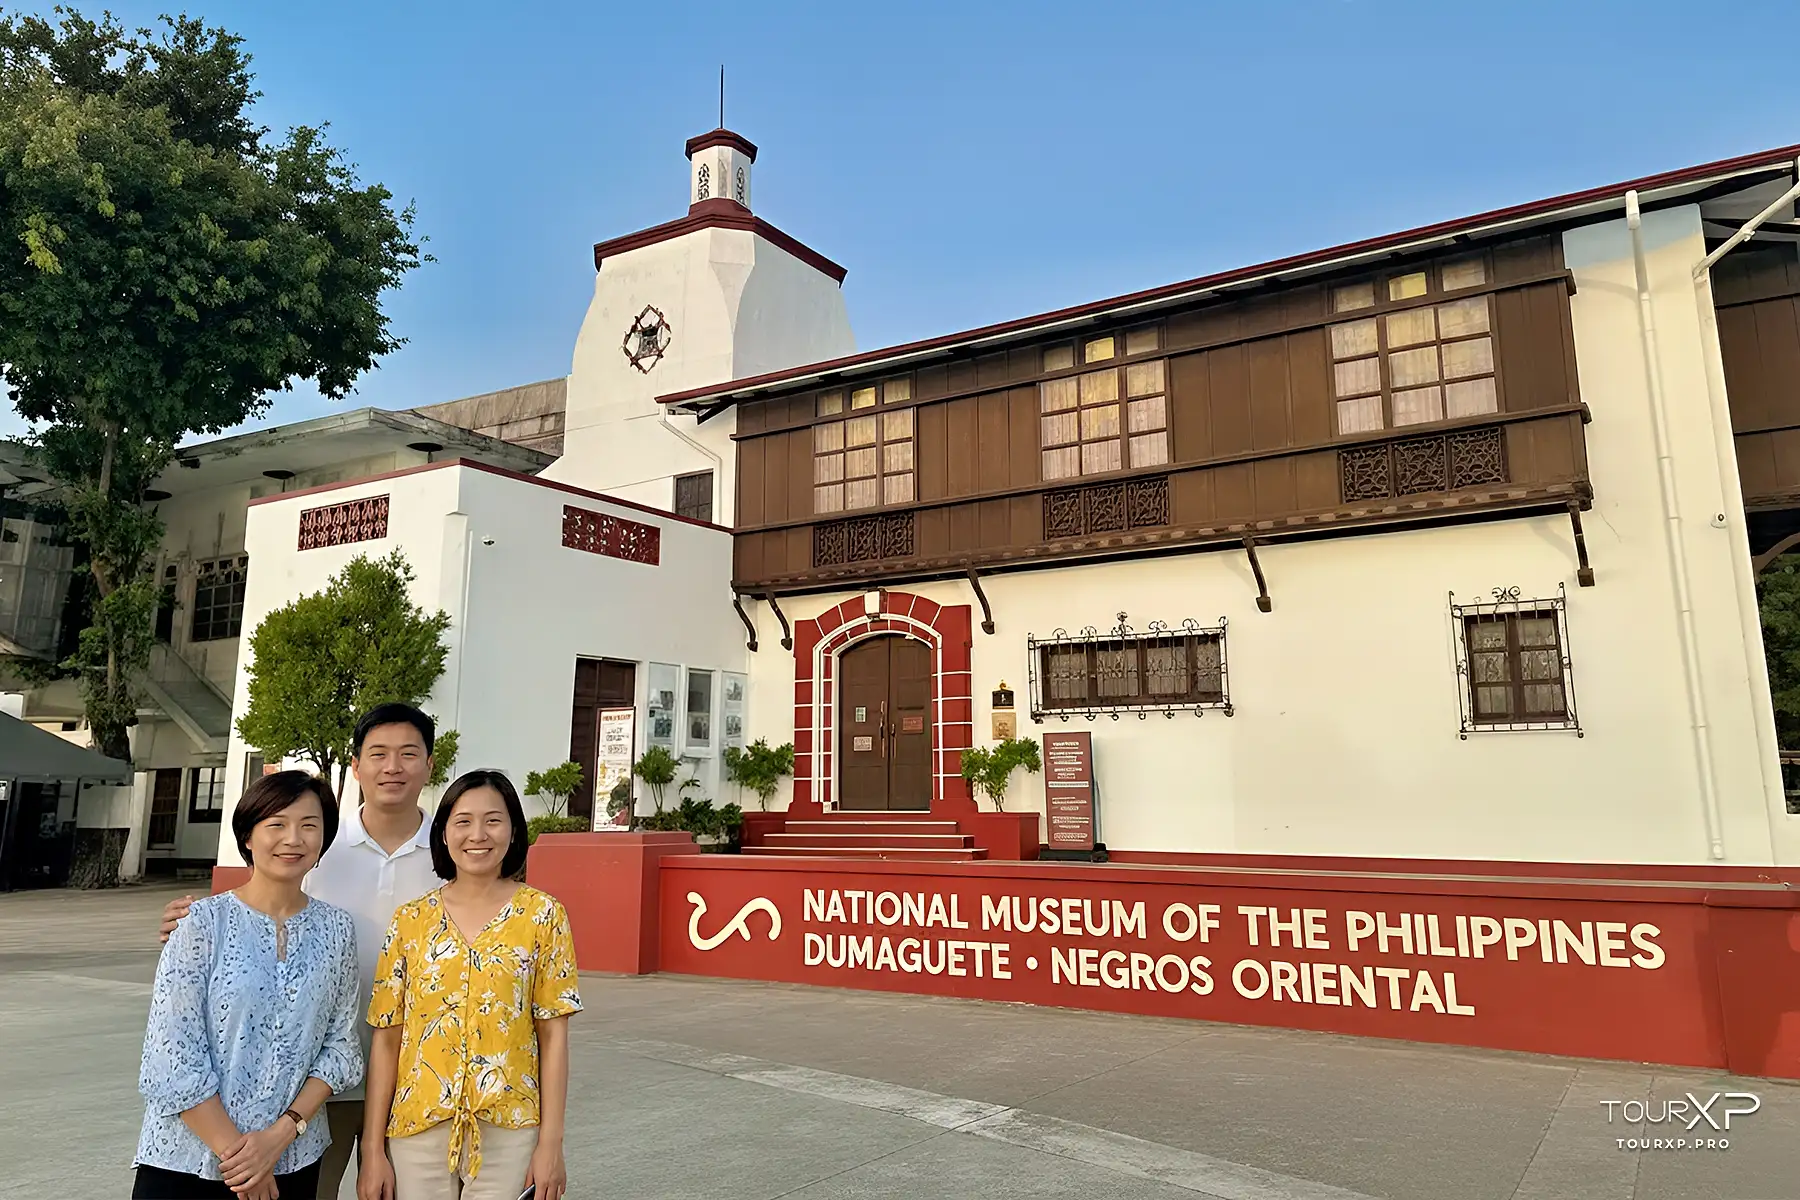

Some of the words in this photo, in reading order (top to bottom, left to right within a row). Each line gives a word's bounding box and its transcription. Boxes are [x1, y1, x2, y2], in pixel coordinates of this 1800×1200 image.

[803, 888, 969, 930] NATIONAL
[981, 894, 1147, 939] MUSEUM
[1162, 902, 1221, 943] OF
[1237, 905, 1330, 950] THE
[1345, 910, 1666, 970] PHILIPPINES
[803, 932, 1012, 980] DUMAGUETE
[1051, 946, 1215, 996] NEGROS
[1231, 958, 1476, 1016] ORIENTAL
